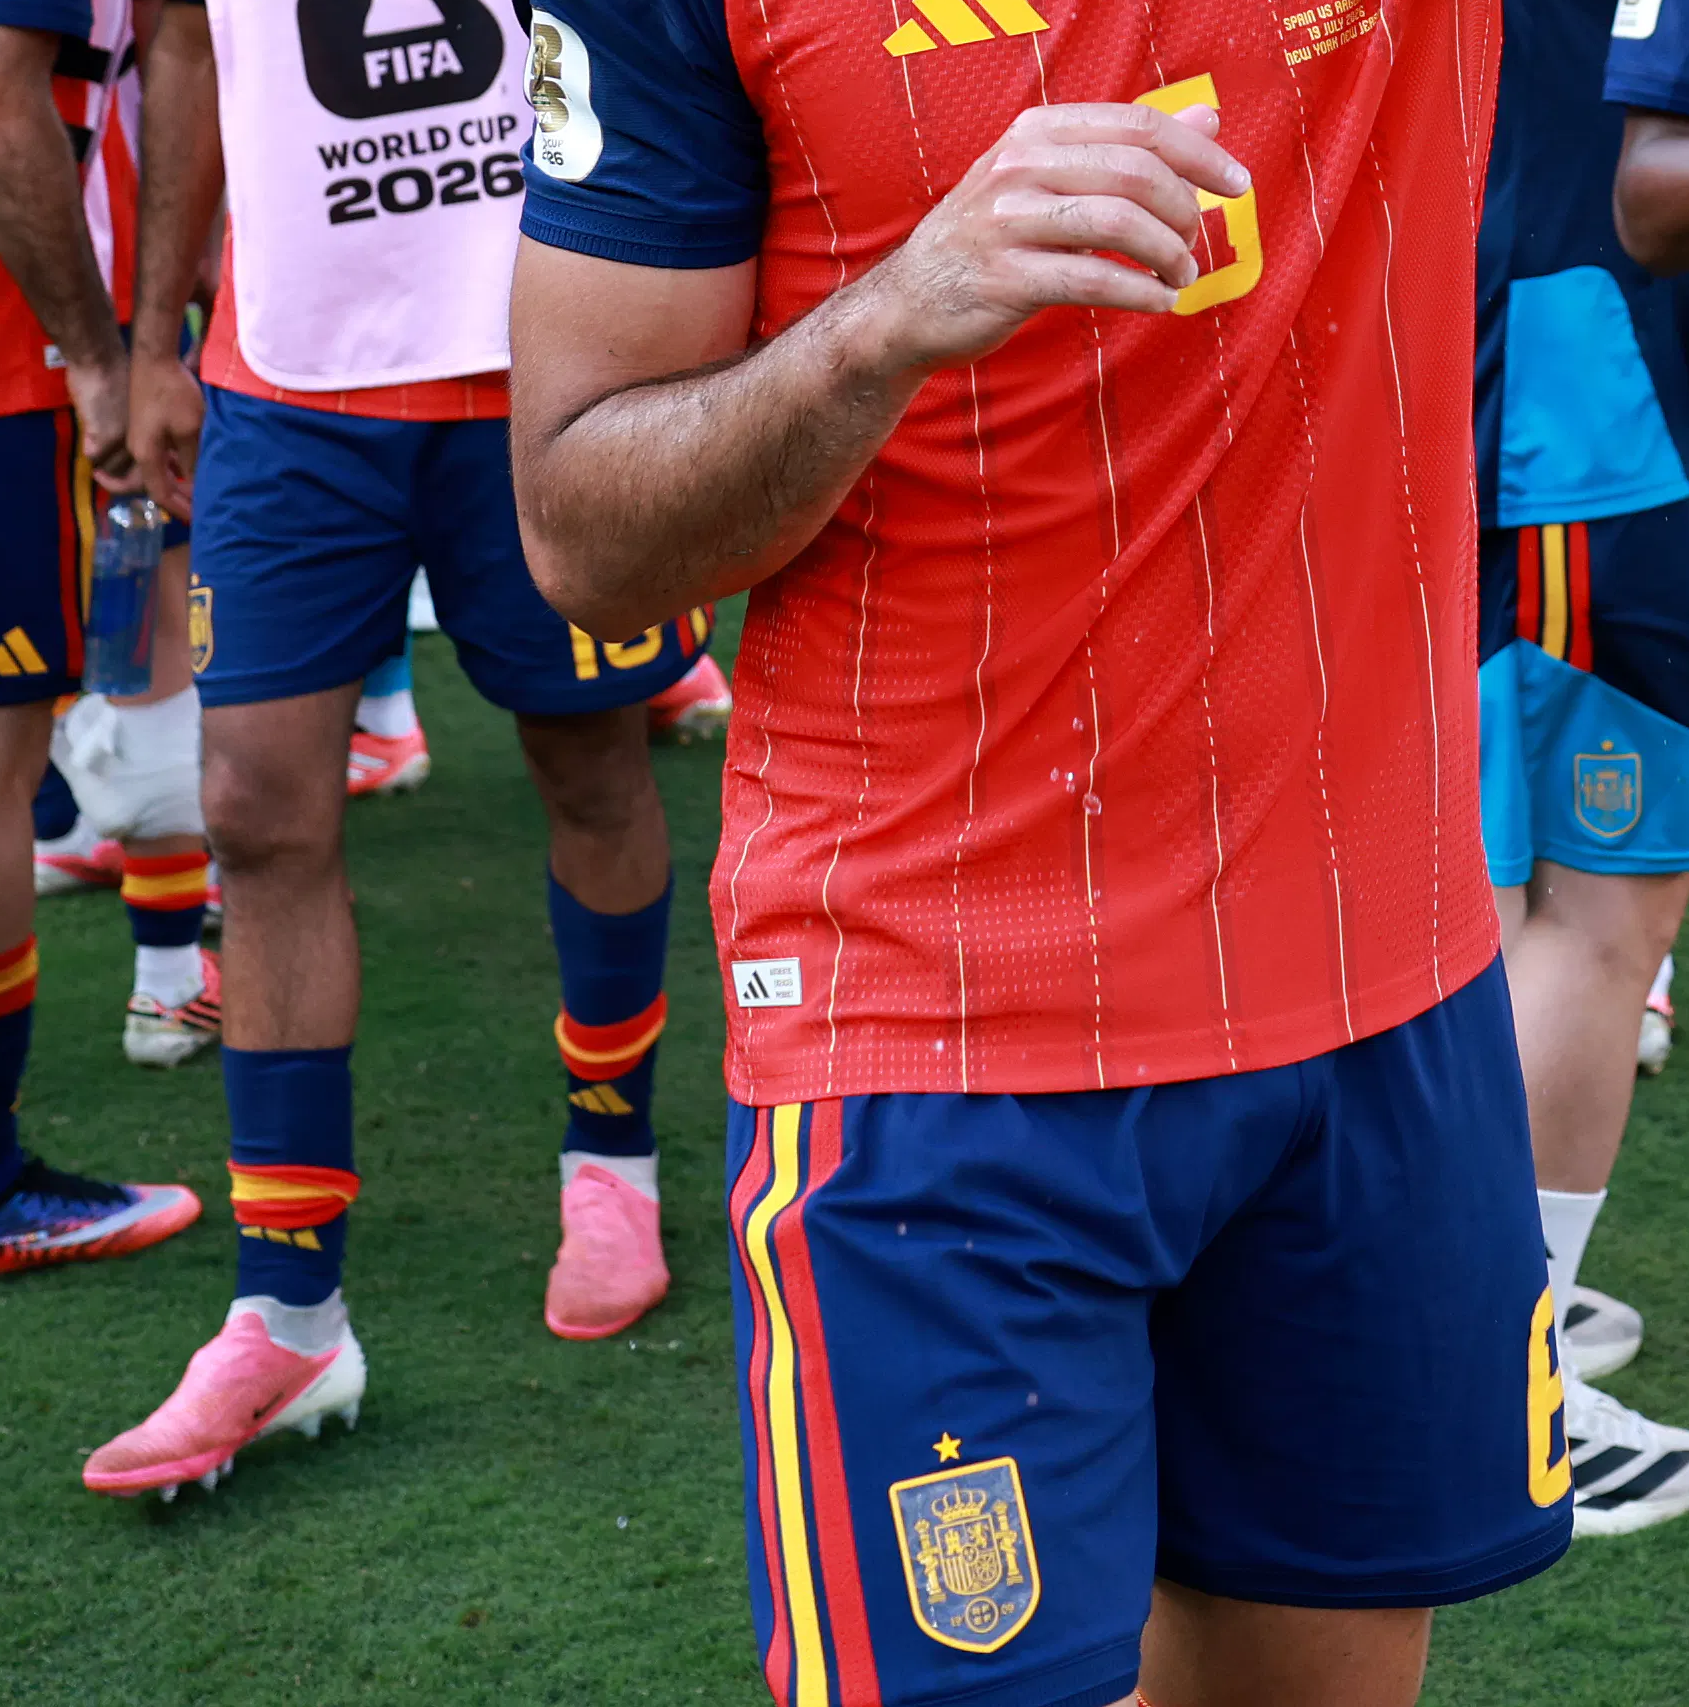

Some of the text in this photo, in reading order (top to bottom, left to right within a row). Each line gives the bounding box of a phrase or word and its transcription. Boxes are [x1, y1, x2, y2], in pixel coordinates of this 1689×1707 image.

[1283, 9, 1316, 31] SPAIN
[1307, 25, 1321, 41] 19
[1323, 16, 1344, 36] JULY
[364, 39, 463, 89] FIFA
[1285, 48, 1312, 66] NEW
[1313, 35, 1339, 57] YORK
[318, 113, 518, 171] WORLD CUP
[324, 153, 526, 224] 2026
